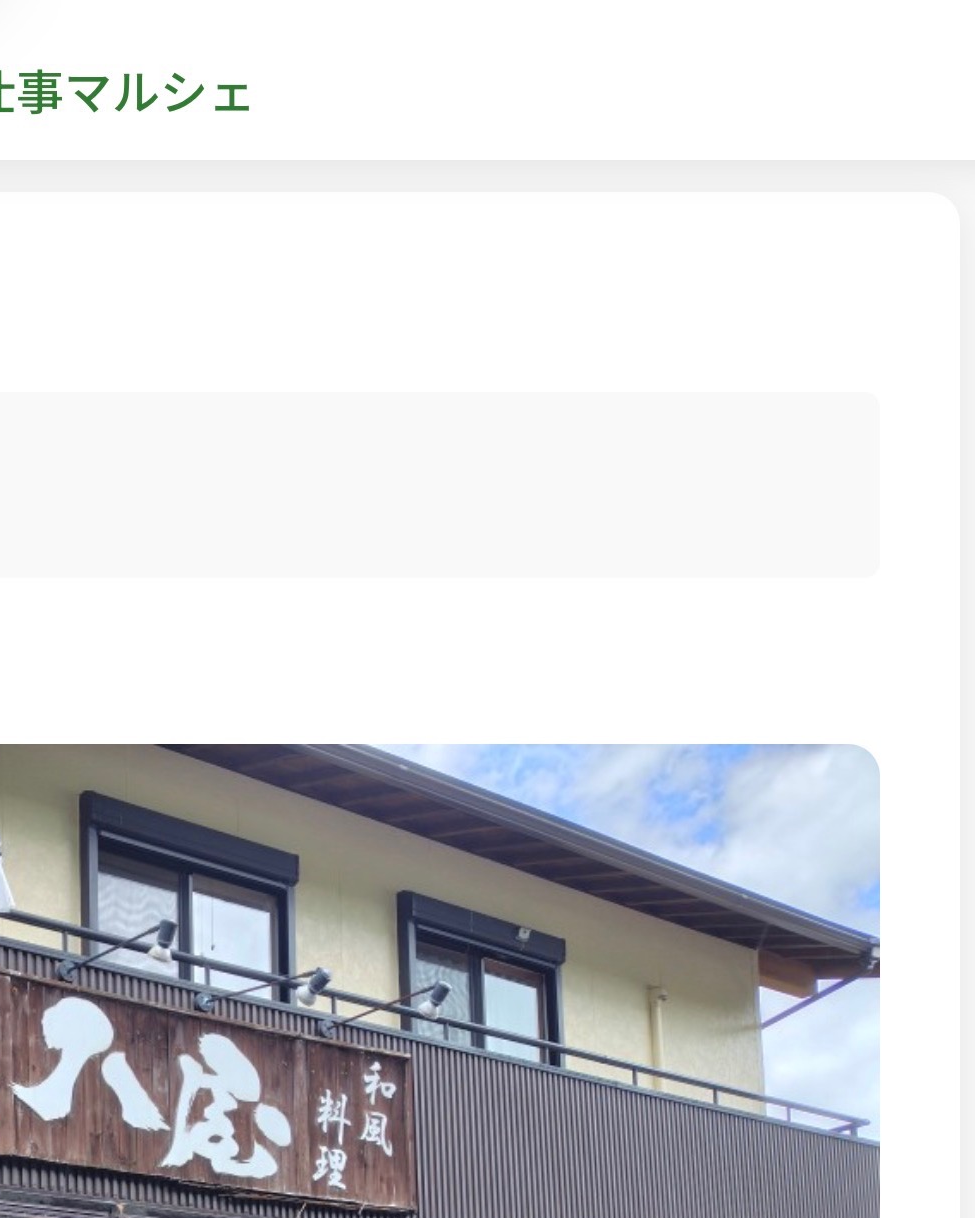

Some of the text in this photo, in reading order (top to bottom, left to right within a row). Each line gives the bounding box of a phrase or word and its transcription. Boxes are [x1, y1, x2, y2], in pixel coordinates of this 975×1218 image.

[7, 996, 292, 1179] 八屋
[360, 1061, 396, 1157] 和風
[312, 1089, 351, 1190] 料理
